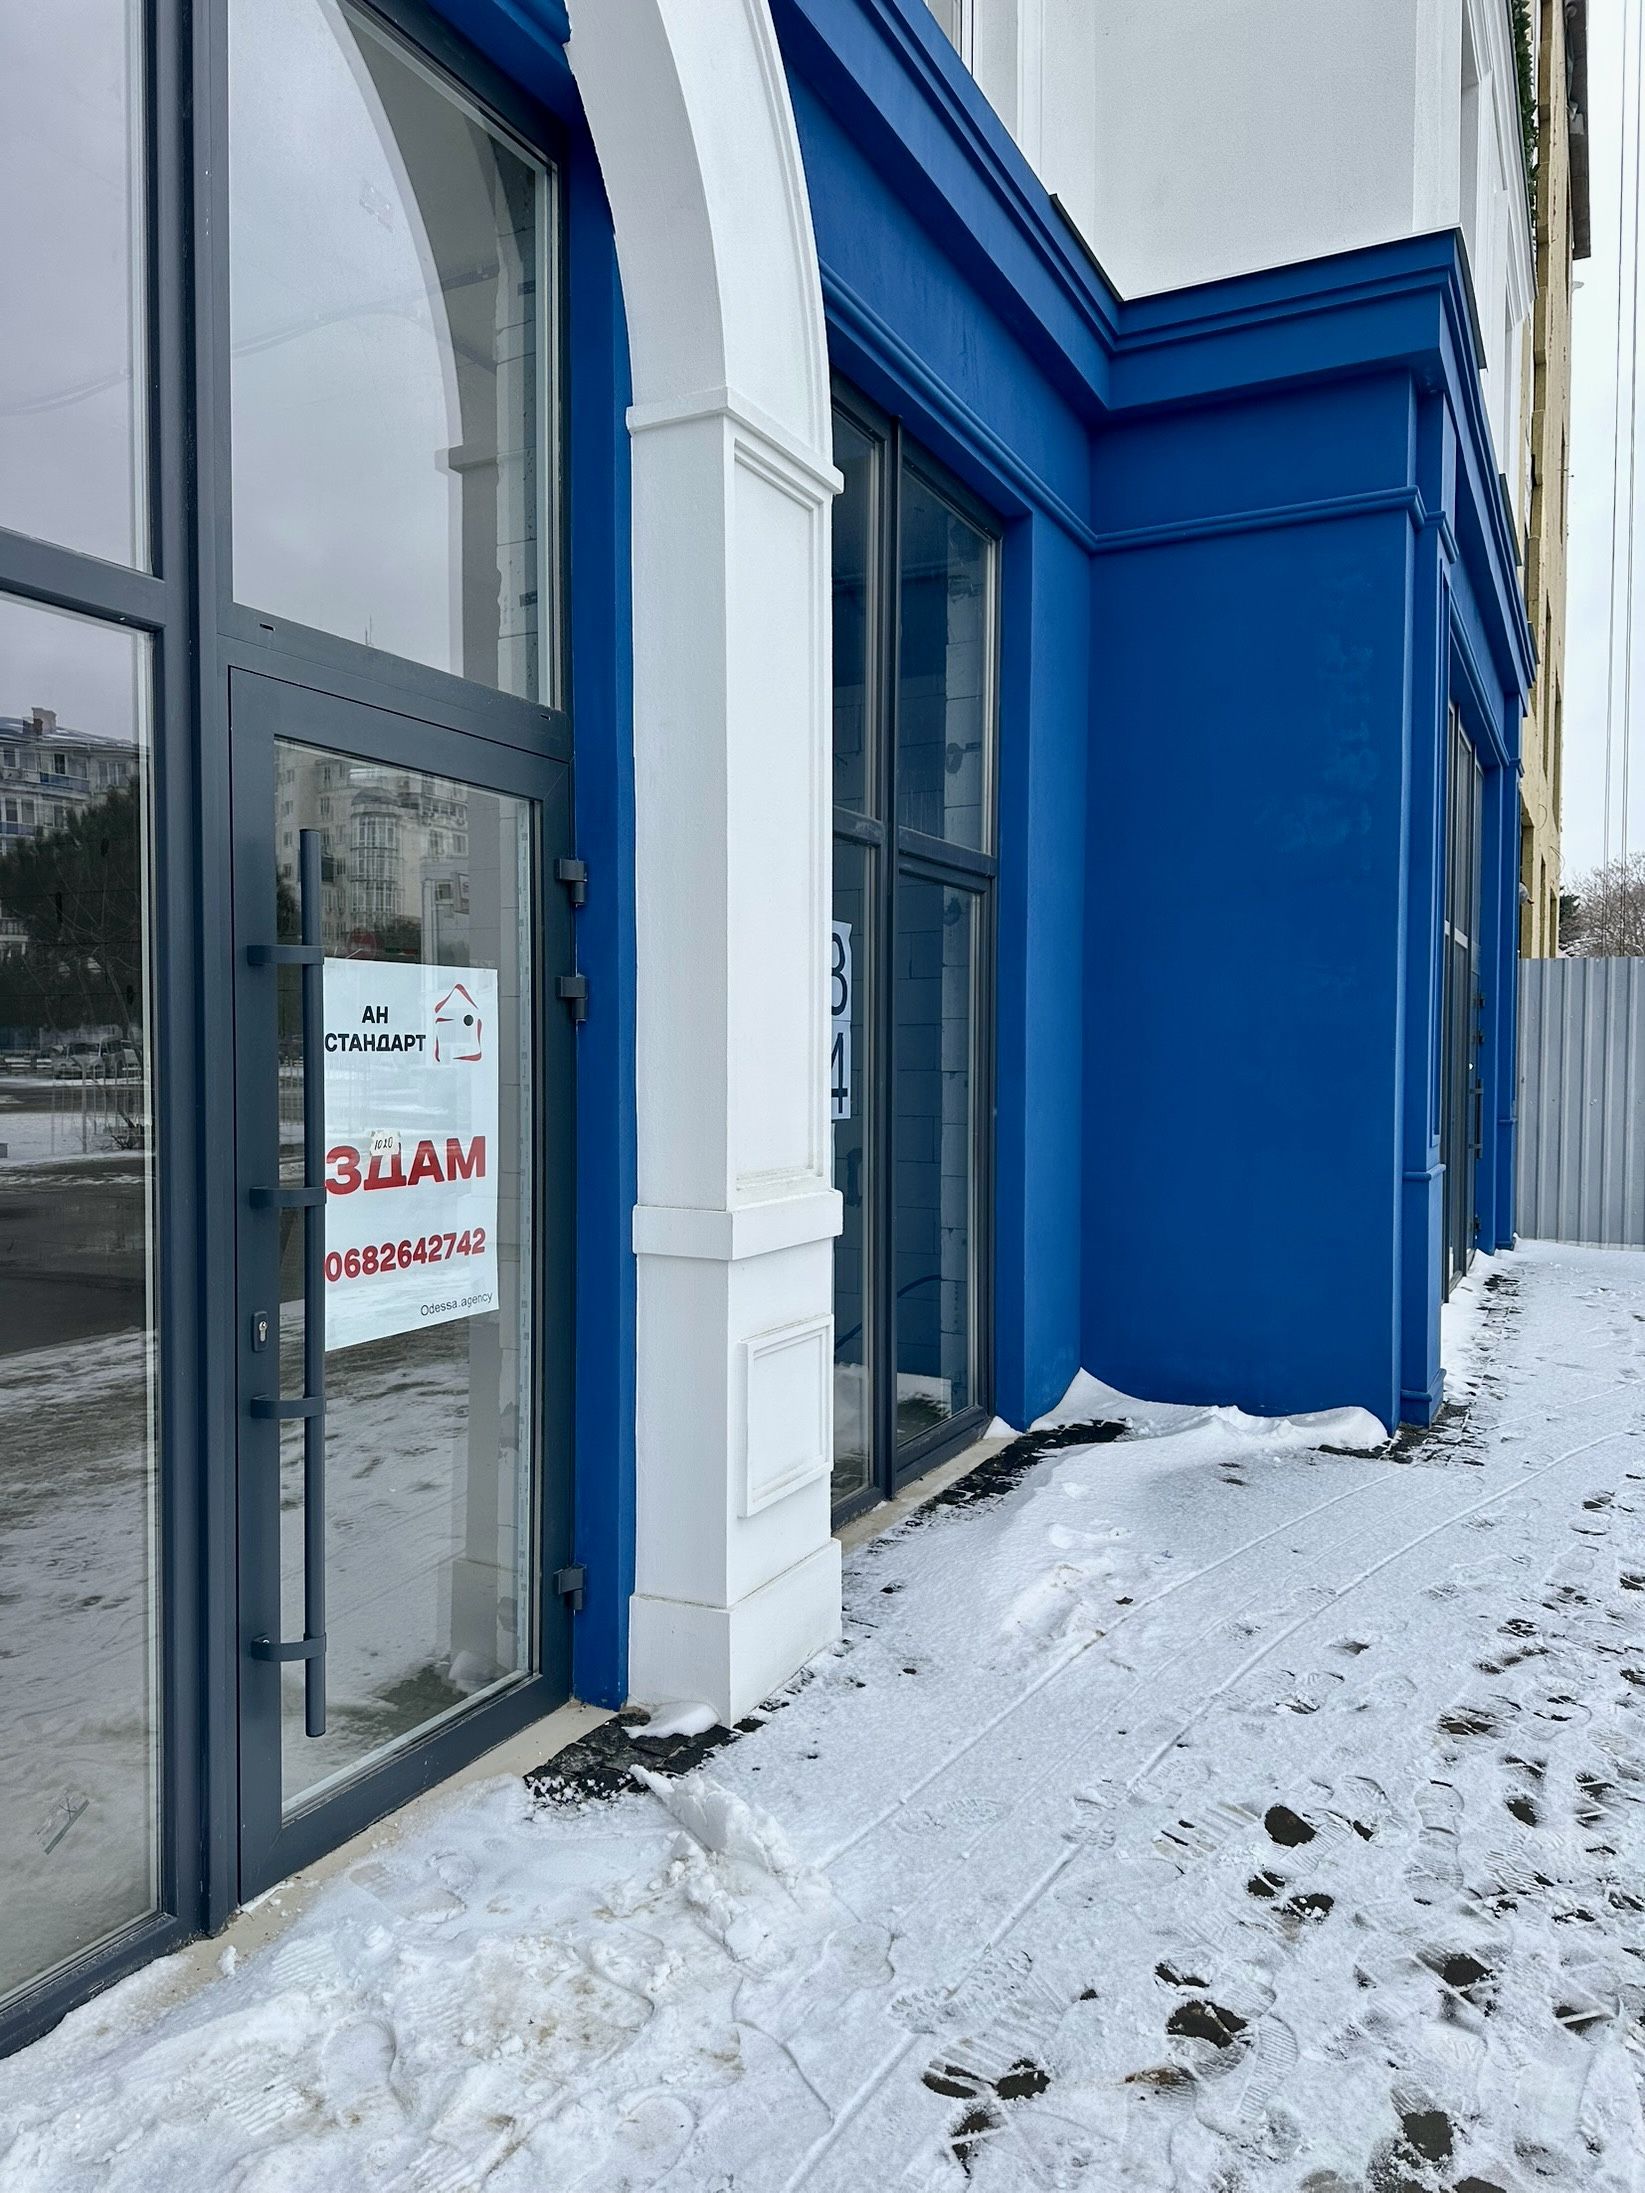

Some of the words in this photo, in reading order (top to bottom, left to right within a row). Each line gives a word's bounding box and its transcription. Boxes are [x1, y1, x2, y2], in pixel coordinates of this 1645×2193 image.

[361, 1005, 388, 1024] АН
[324, 1033, 426, 1052] СТАНДАРТ
[325, 1136, 486, 1195] ЗДАМ
[325, 1228, 486, 1282] 0682642742
[420, 1292, 493, 1316] Odessa.agency
